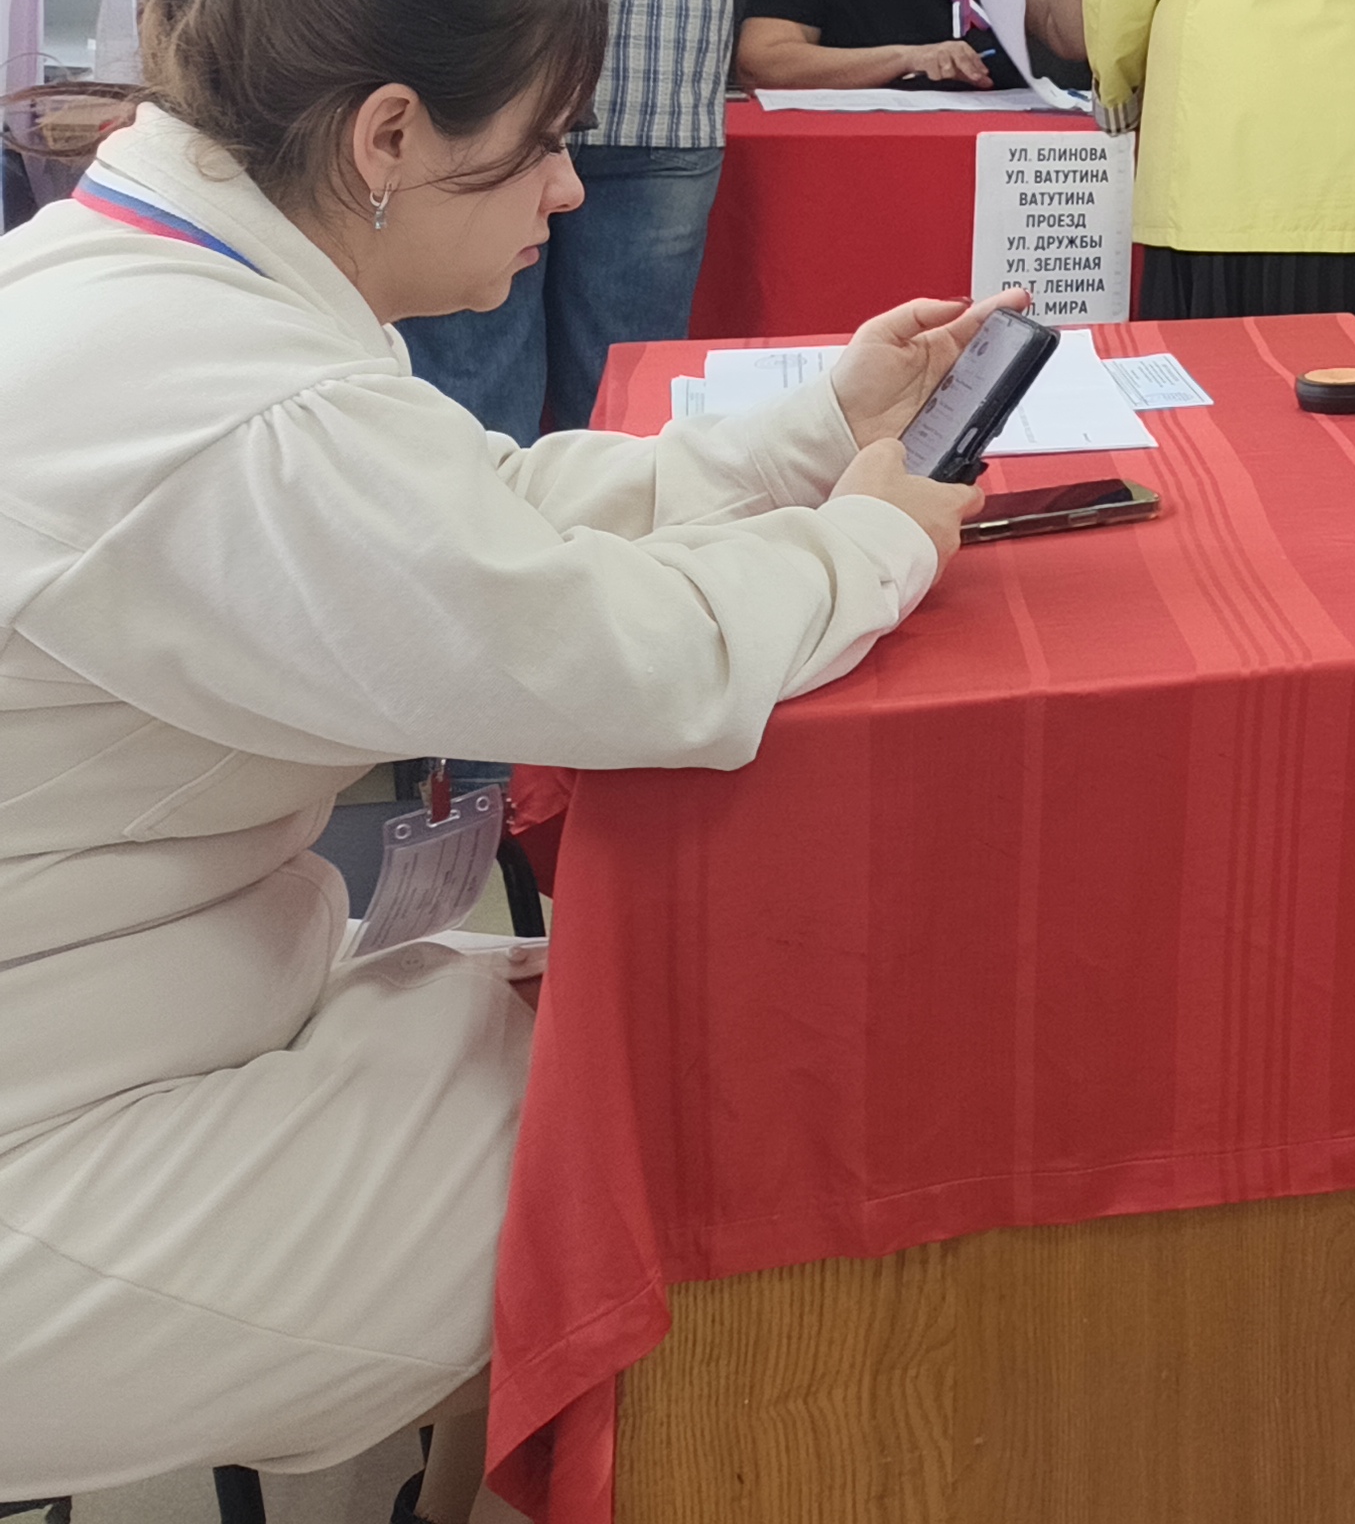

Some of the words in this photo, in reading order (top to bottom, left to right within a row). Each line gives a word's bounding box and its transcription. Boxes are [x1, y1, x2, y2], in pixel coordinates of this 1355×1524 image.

[1008, 148, 1032, 163] УЛ.
[1037, 147, 1108, 162] БЛИНОВА
[1005, 170, 1029, 184] УЛ.
[1034, 169, 1109, 184] ВАТУТИНА
[1019, 191, 1095, 206] ВАТУТИНА
[1026, 213, 1087, 229] ПРОЕЗД
[1007, 236, 1031, 251] УЛ.
[1034, 234, 1103, 251] ДРУЖБЫ
[1006, 258, 1030, 273] УЛ.
[1034, 256, 1102, 272] ЗЕЛЕНАЯ
[1043, 278, 1106, 294] ЛЕНИНА
[1044, 300, 1088, 316] МИРА
